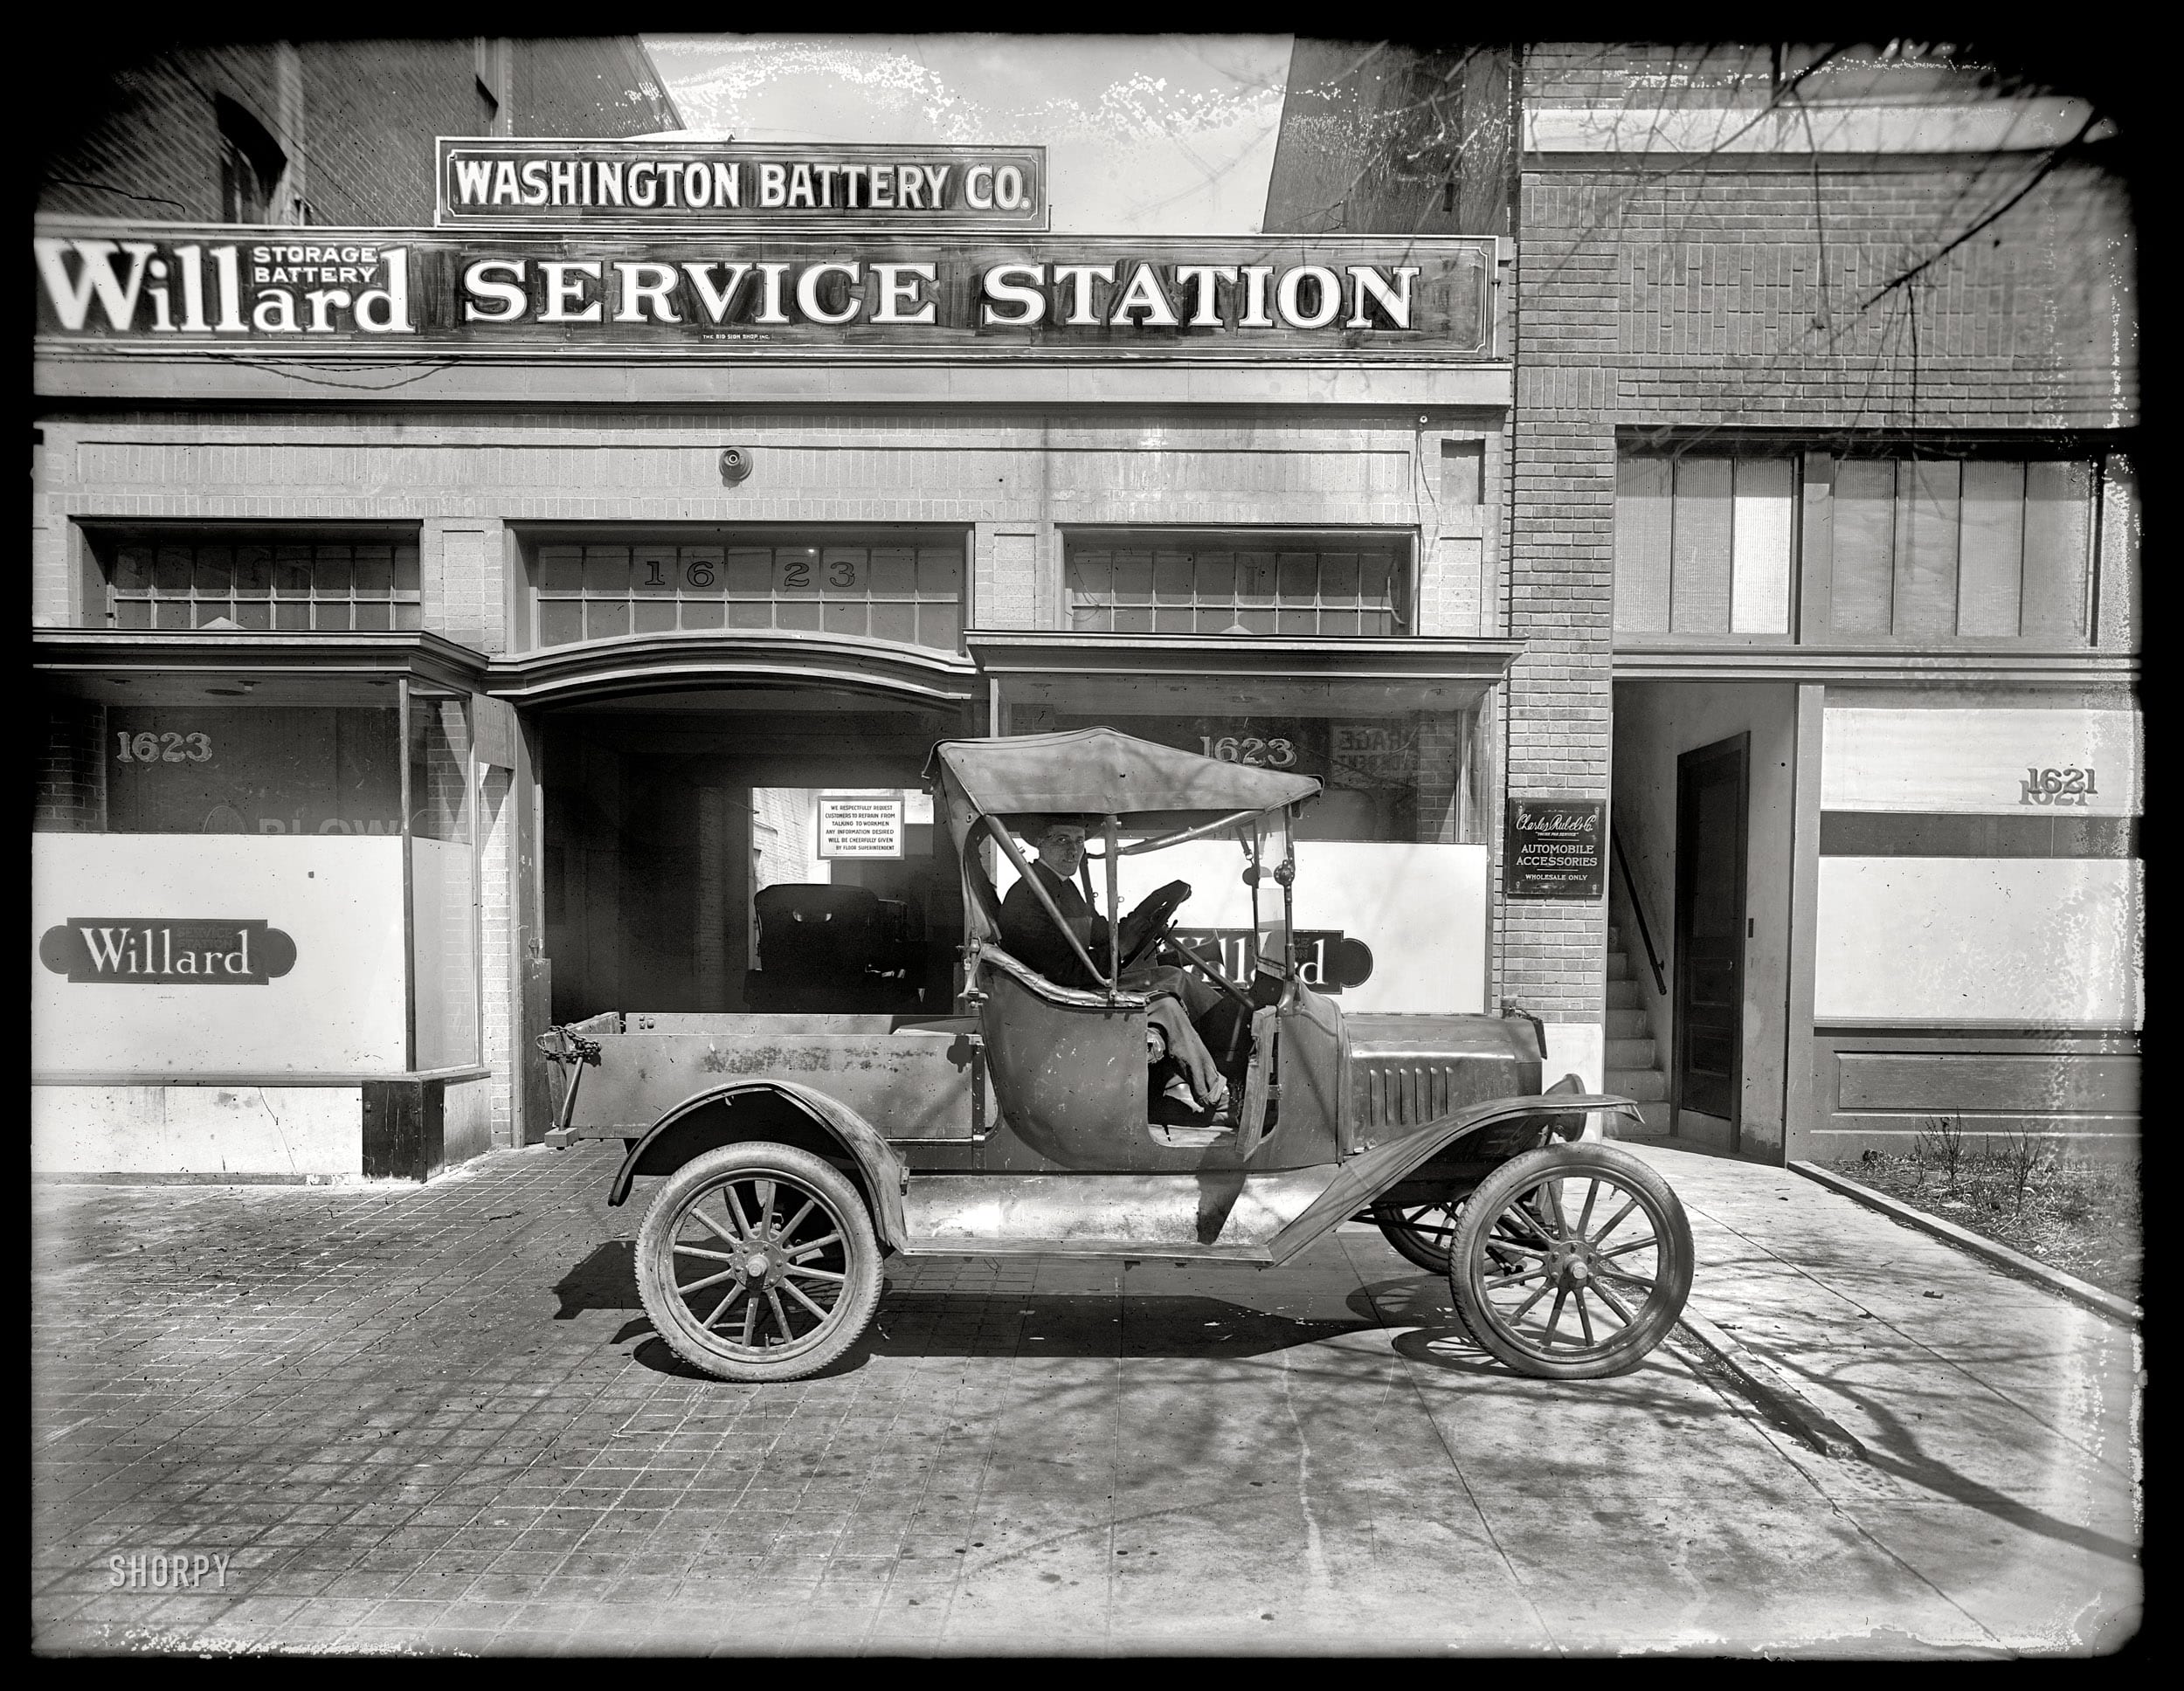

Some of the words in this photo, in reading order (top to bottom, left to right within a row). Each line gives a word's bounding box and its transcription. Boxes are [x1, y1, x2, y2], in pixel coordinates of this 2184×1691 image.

[455, 160, 740, 209] WASHINGTON
[758, 162, 946, 210] BATTERY
[964, 164, 1030, 211] CO.
[252, 245, 378, 264] STORAGE
[33, 238, 417, 334] Willard
[253, 266, 378, 283] BATTERY
[463, 260, 937, 327] SERVICE
[982, 263, 1421, 330] STATION
[116, 731, 213, 763] 1623
[1199, 735, 1297, 768] 1623
[2026, 768, 2098, 794] 1621
[1516, 856, 1598, 866] ACCESSORIES
[1521, 844, 1595, 854] AUTOMOBILE
[79, 927, 253, 975] Willard
